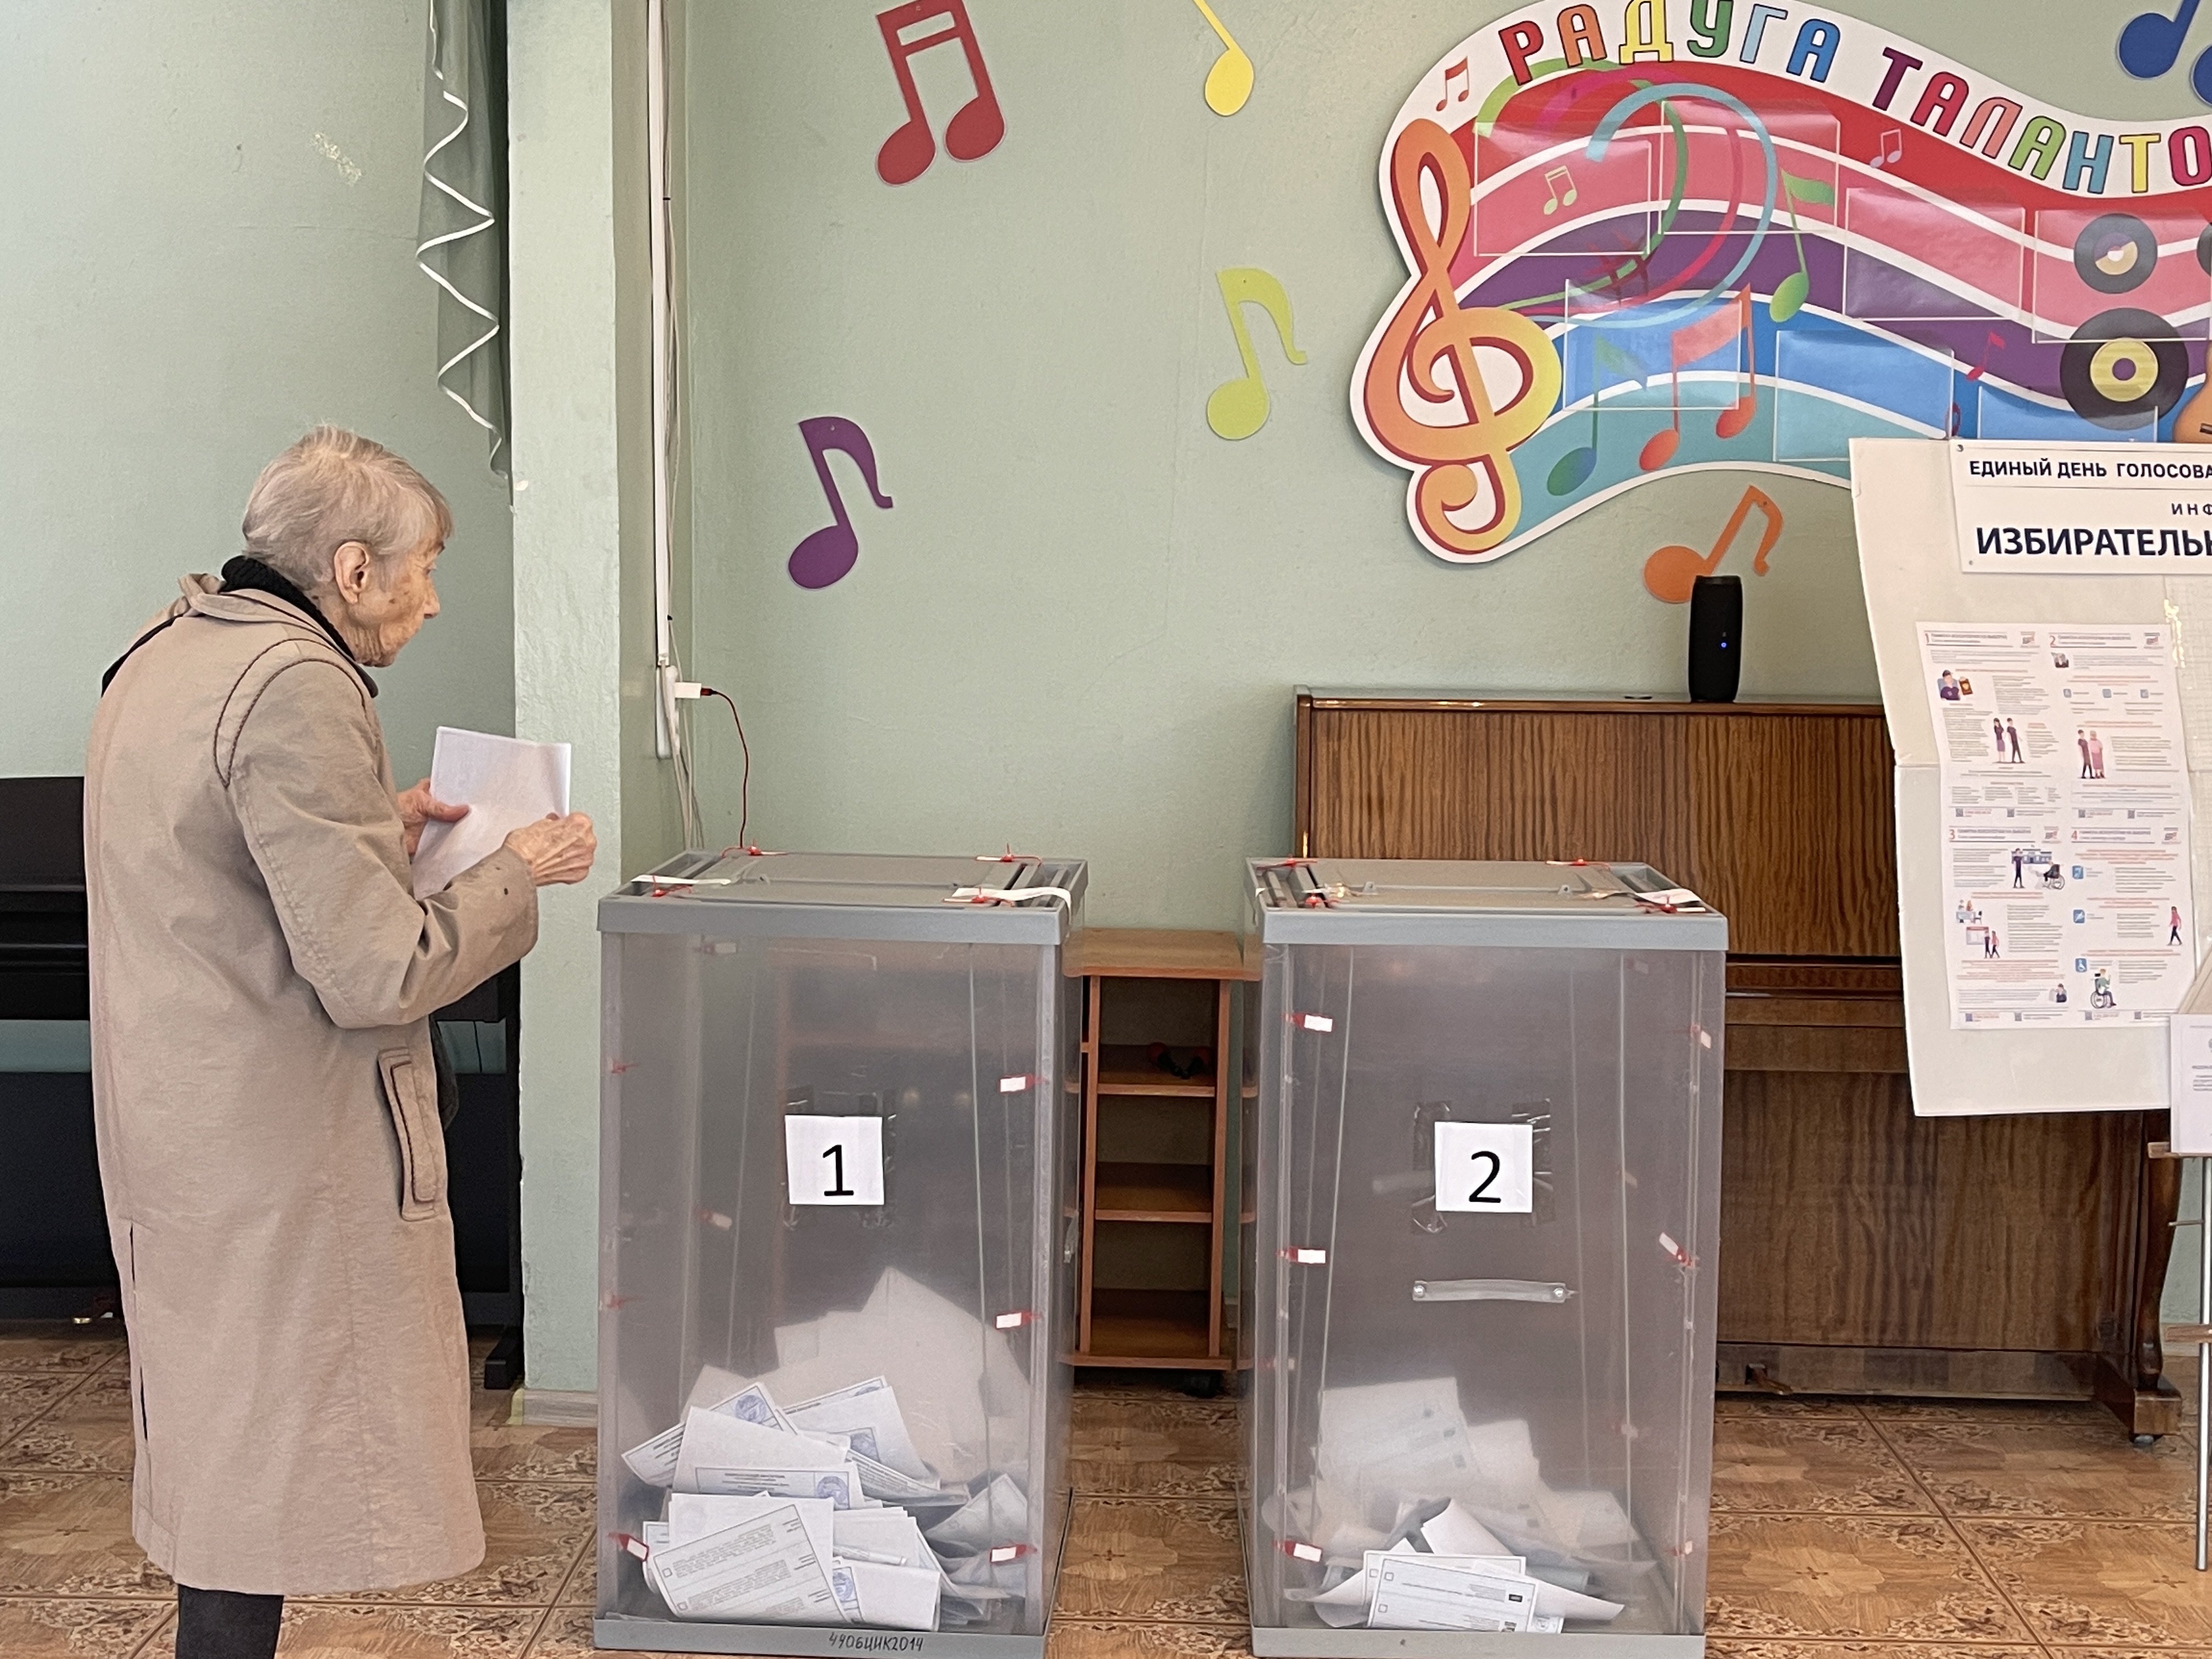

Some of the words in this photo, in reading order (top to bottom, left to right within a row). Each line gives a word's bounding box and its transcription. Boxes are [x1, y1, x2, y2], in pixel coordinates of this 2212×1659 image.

[1498, 0, 1842, 86] РАДУГА
[1970, 458, 2052, 477] ЕДИНЫЙ
[2057, 462, 2107, 478] ДЕНЬ
[1949, 829, 1955, 839] 3
[2072, 830, 2078, 839] 4
[822, 1144, 854, 1196] 1
[1469, 1150, 1501, 1203] 2
